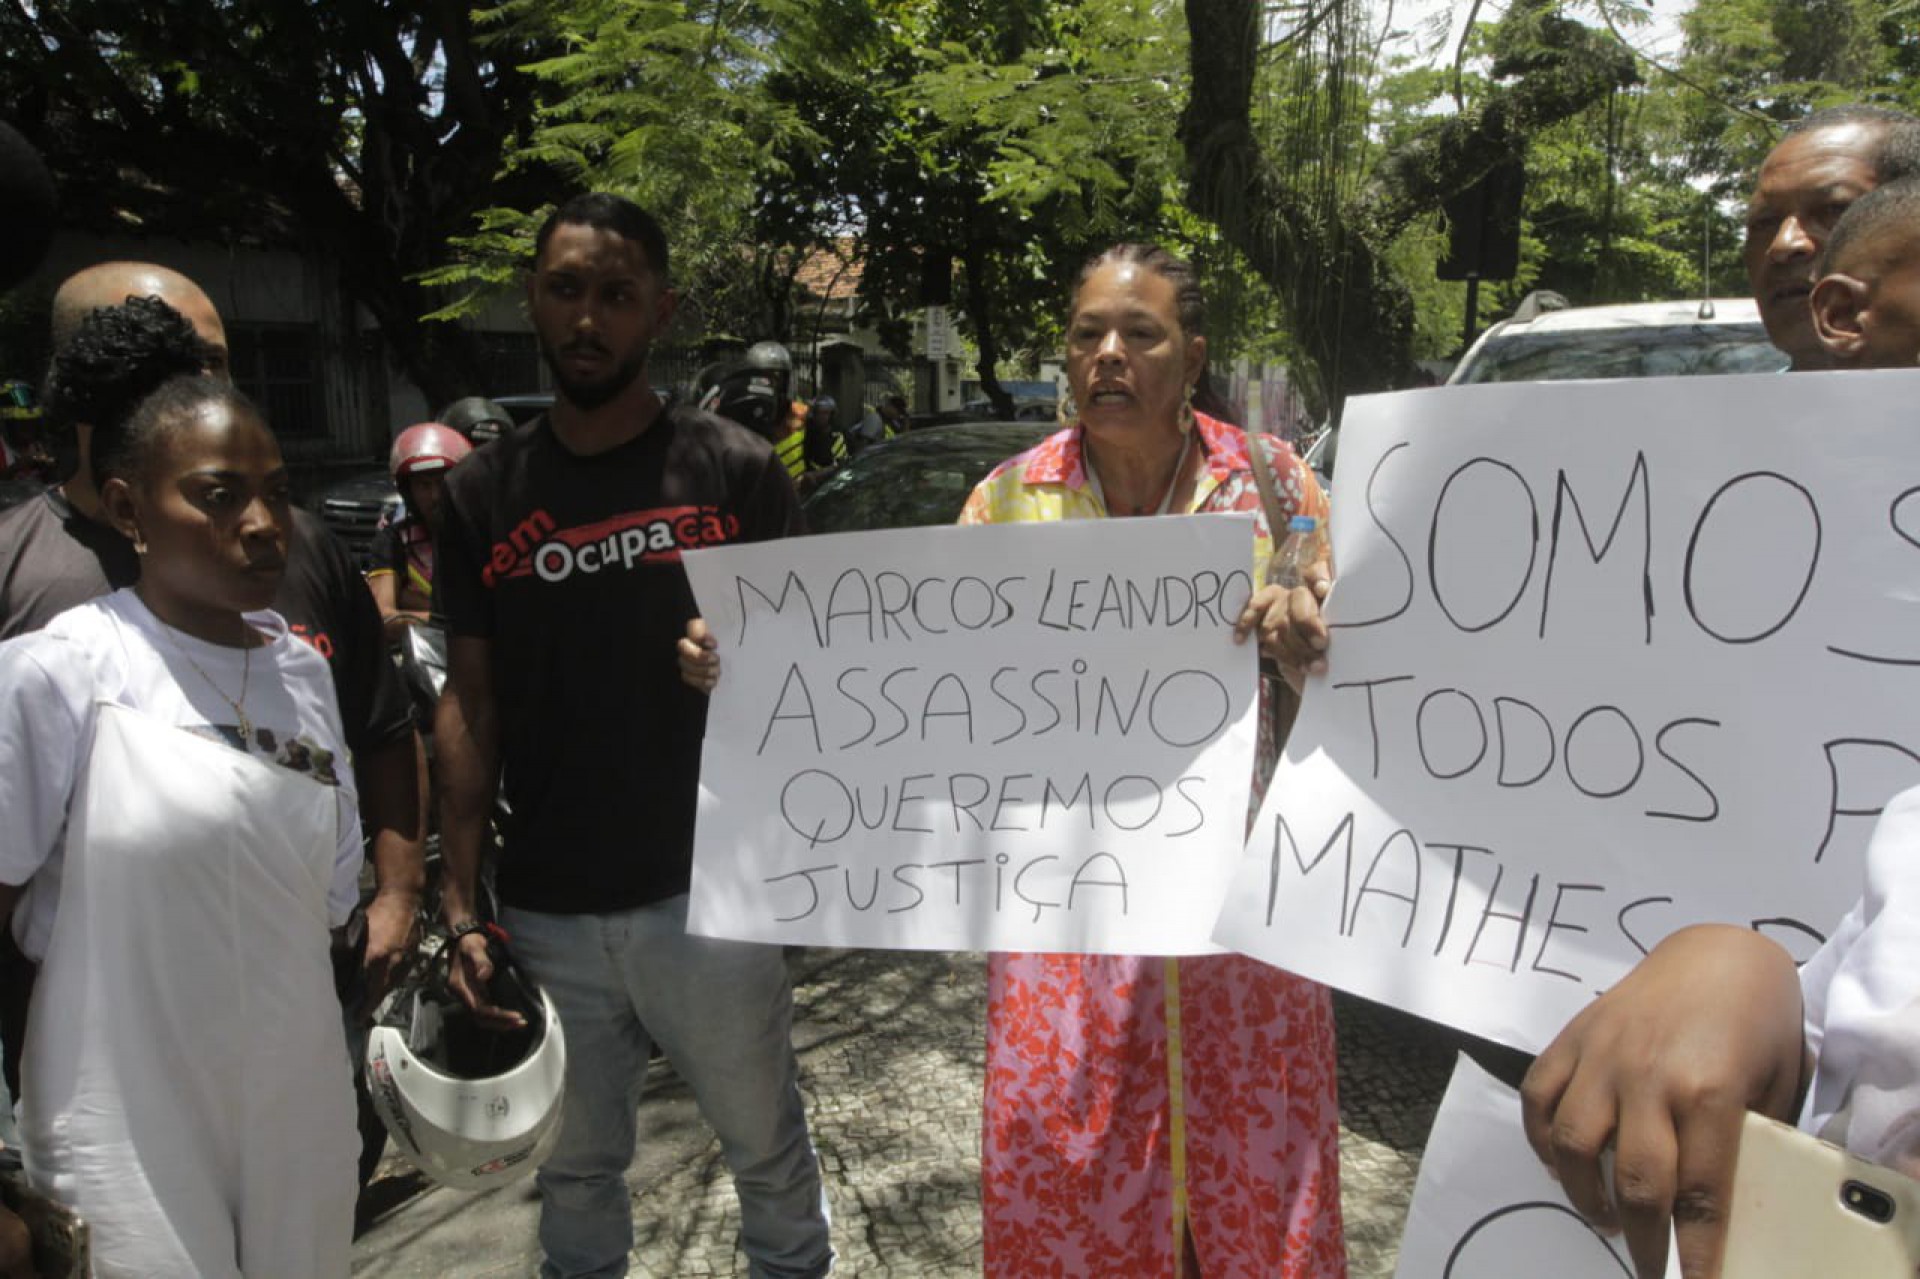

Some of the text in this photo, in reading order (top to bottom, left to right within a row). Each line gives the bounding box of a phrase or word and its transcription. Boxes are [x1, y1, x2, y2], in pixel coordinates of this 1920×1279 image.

[736, 567, 1253, 648] MARCOS LEANDRO
[1332, 675, 1721, 823] TODOS
[780, 768, 1206, 850] QUEREMOS
